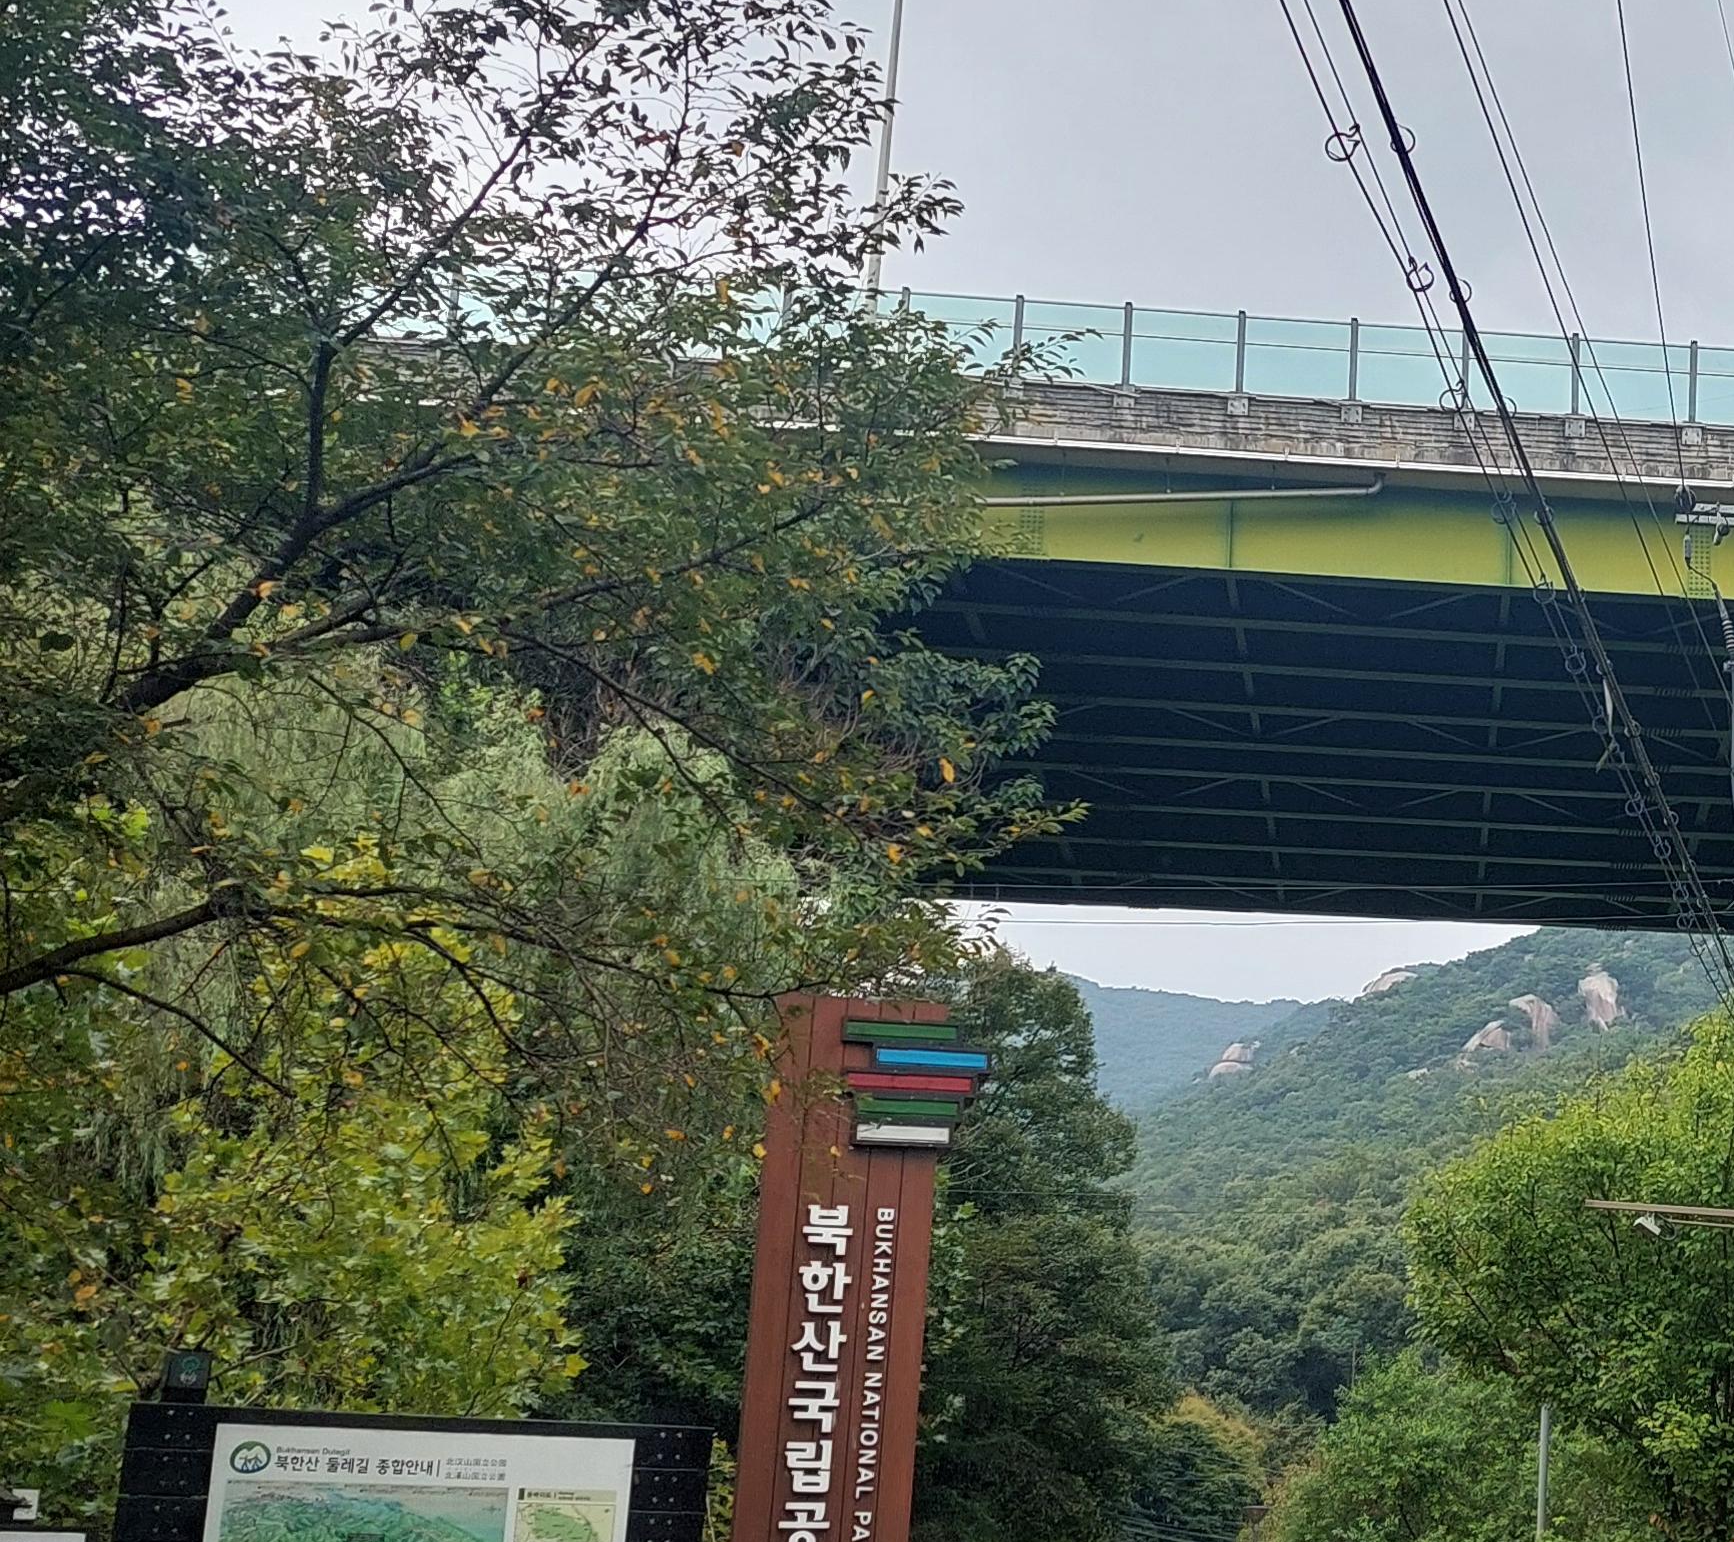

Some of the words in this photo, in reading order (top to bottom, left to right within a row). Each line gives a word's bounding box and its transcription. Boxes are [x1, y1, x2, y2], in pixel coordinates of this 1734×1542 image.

[866, 1207, 895, 1361] BUKHANSAN
[274, 1455, 320, 1473] 북한산
[325, 1457, 370, 1476] 둘레길
[375, 1458, 434, 1478] 종합안내
[855, 1372, 883, 1500] NATIONAL
